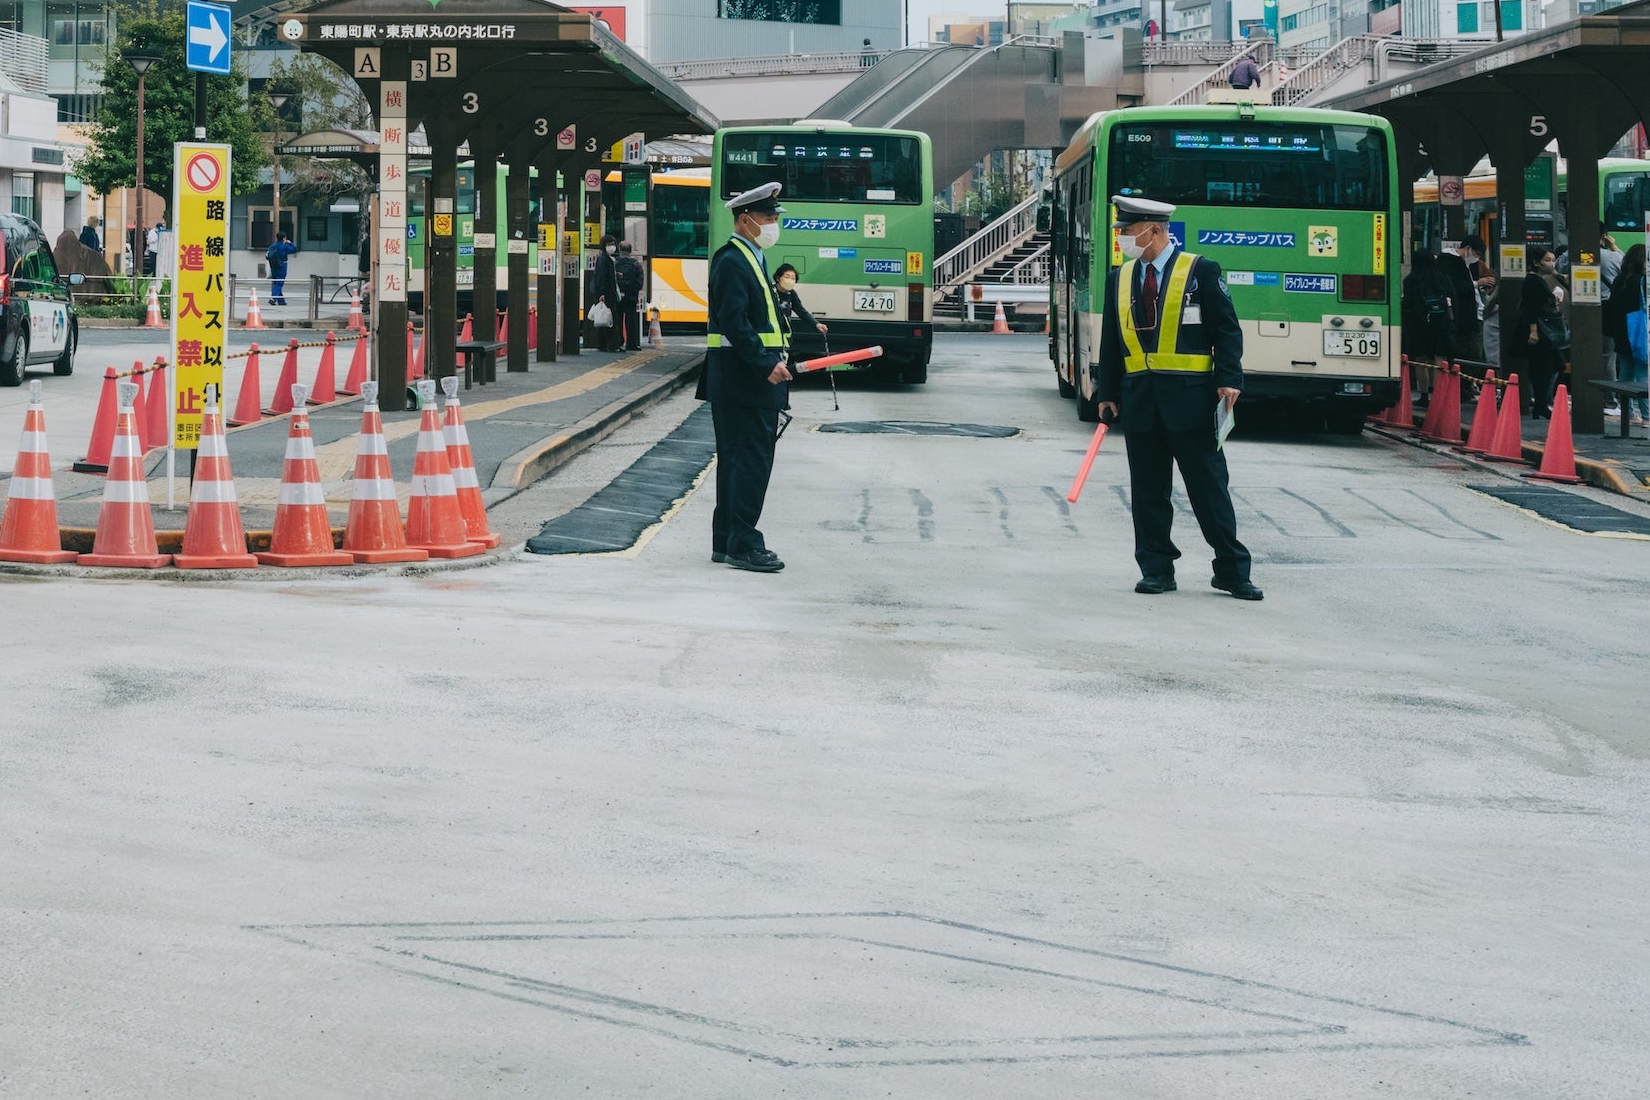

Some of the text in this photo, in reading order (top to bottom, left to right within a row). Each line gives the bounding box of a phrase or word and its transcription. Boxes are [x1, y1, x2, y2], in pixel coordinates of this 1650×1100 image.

[320, 23, 516, 39] 東陽町駅・東京駅丸の内北口行
[358, 53, 377, 73] A
[435, 52, 452, 73] B
[414, 63, 424, 79] 3
[462, 92, 479, 114] 3
[533, 118, 549, 136] 3
[1530, 115, 1549, 137] 5
[584, 137, 598, 153] 3
[1128, 134, 1152, 143] E509
[728, 154, 752, 162] W441
[384, 90, 403, 292] 横断歩道優先
[783, 218, 857, 231] ノンステップバス
[1200, 231, 1295, 247] ノンステップバス
[861, 297, 893, 310] 24-70
[177, 245, 204, 414] 進入禁止
